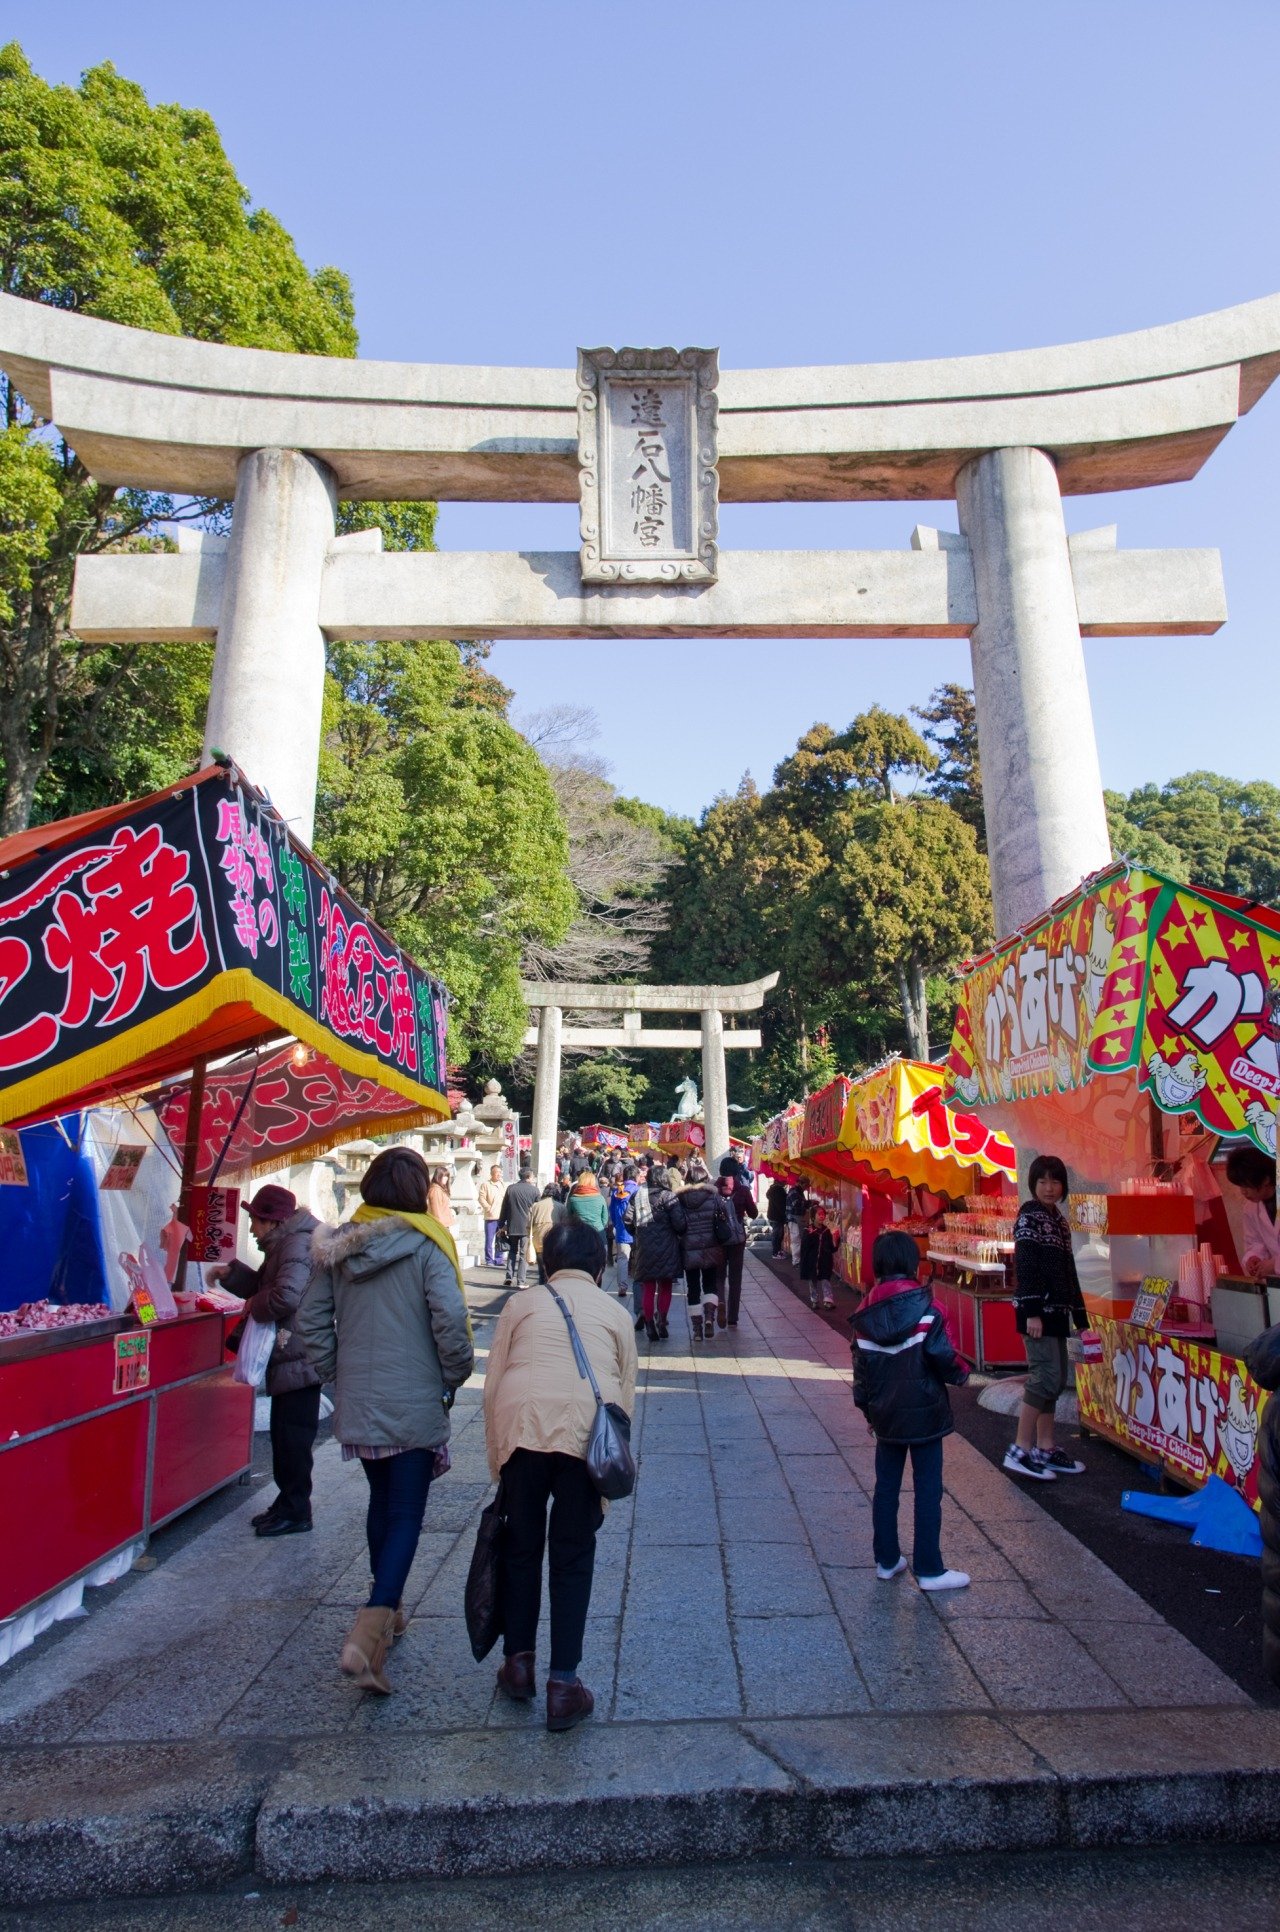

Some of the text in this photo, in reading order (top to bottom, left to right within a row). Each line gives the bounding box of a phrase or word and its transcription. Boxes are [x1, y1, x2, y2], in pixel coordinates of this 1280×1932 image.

[984, 944, 1086, 1064] からあげ
[205, 1191, 225, 1261] たこやき
[1113, 1344, 1225, 1459] からあげ
[1128, 1419, 1203, 1468] Deep-Fried Chicken
